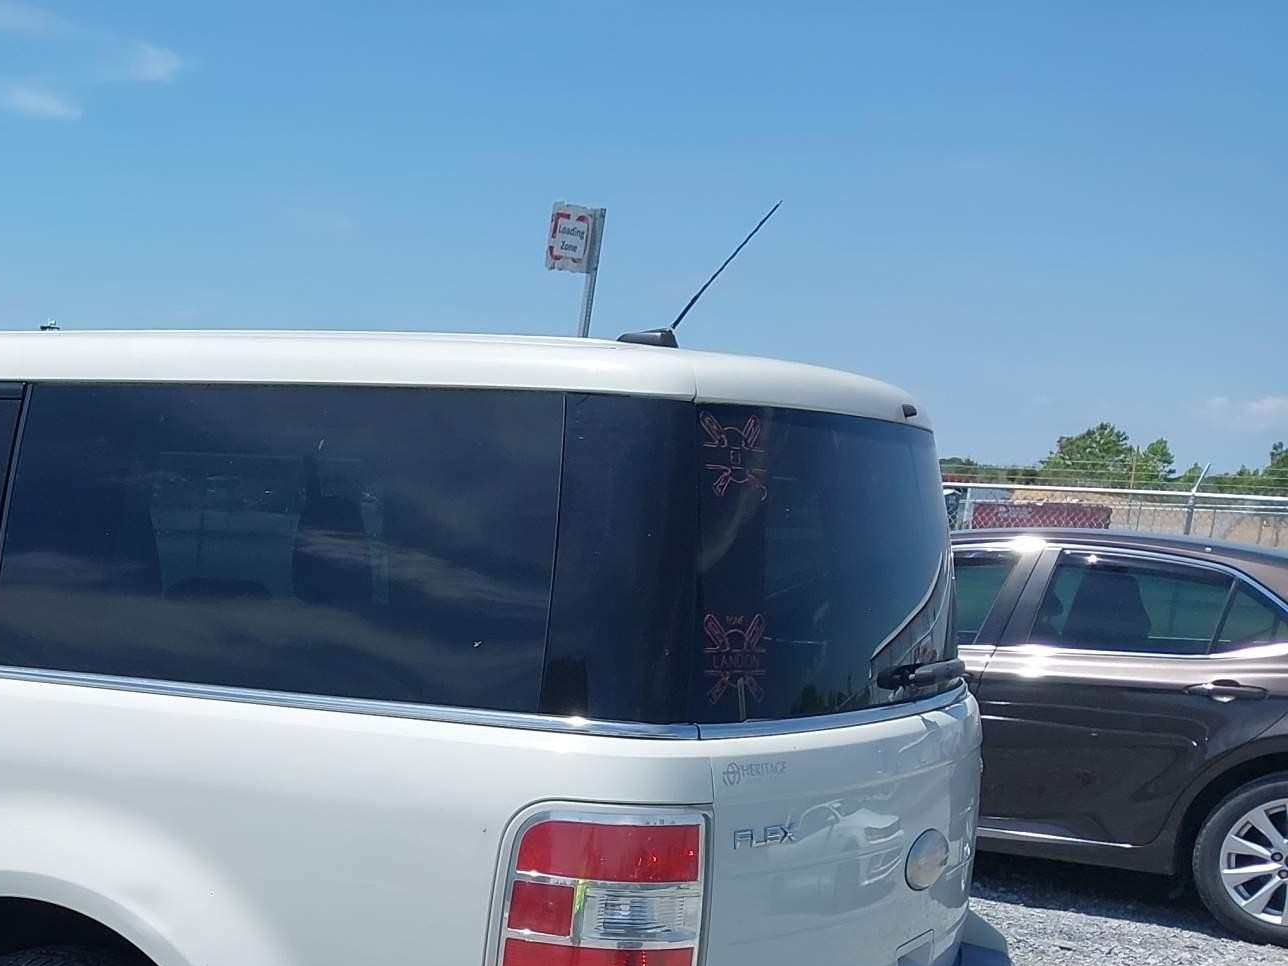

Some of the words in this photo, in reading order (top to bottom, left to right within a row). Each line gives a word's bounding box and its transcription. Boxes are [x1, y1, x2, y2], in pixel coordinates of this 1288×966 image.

[558, 224, 586, 240] Loading
[560, 240, 578, 252] Zone
[733, 822, 795, 850] FLEX
